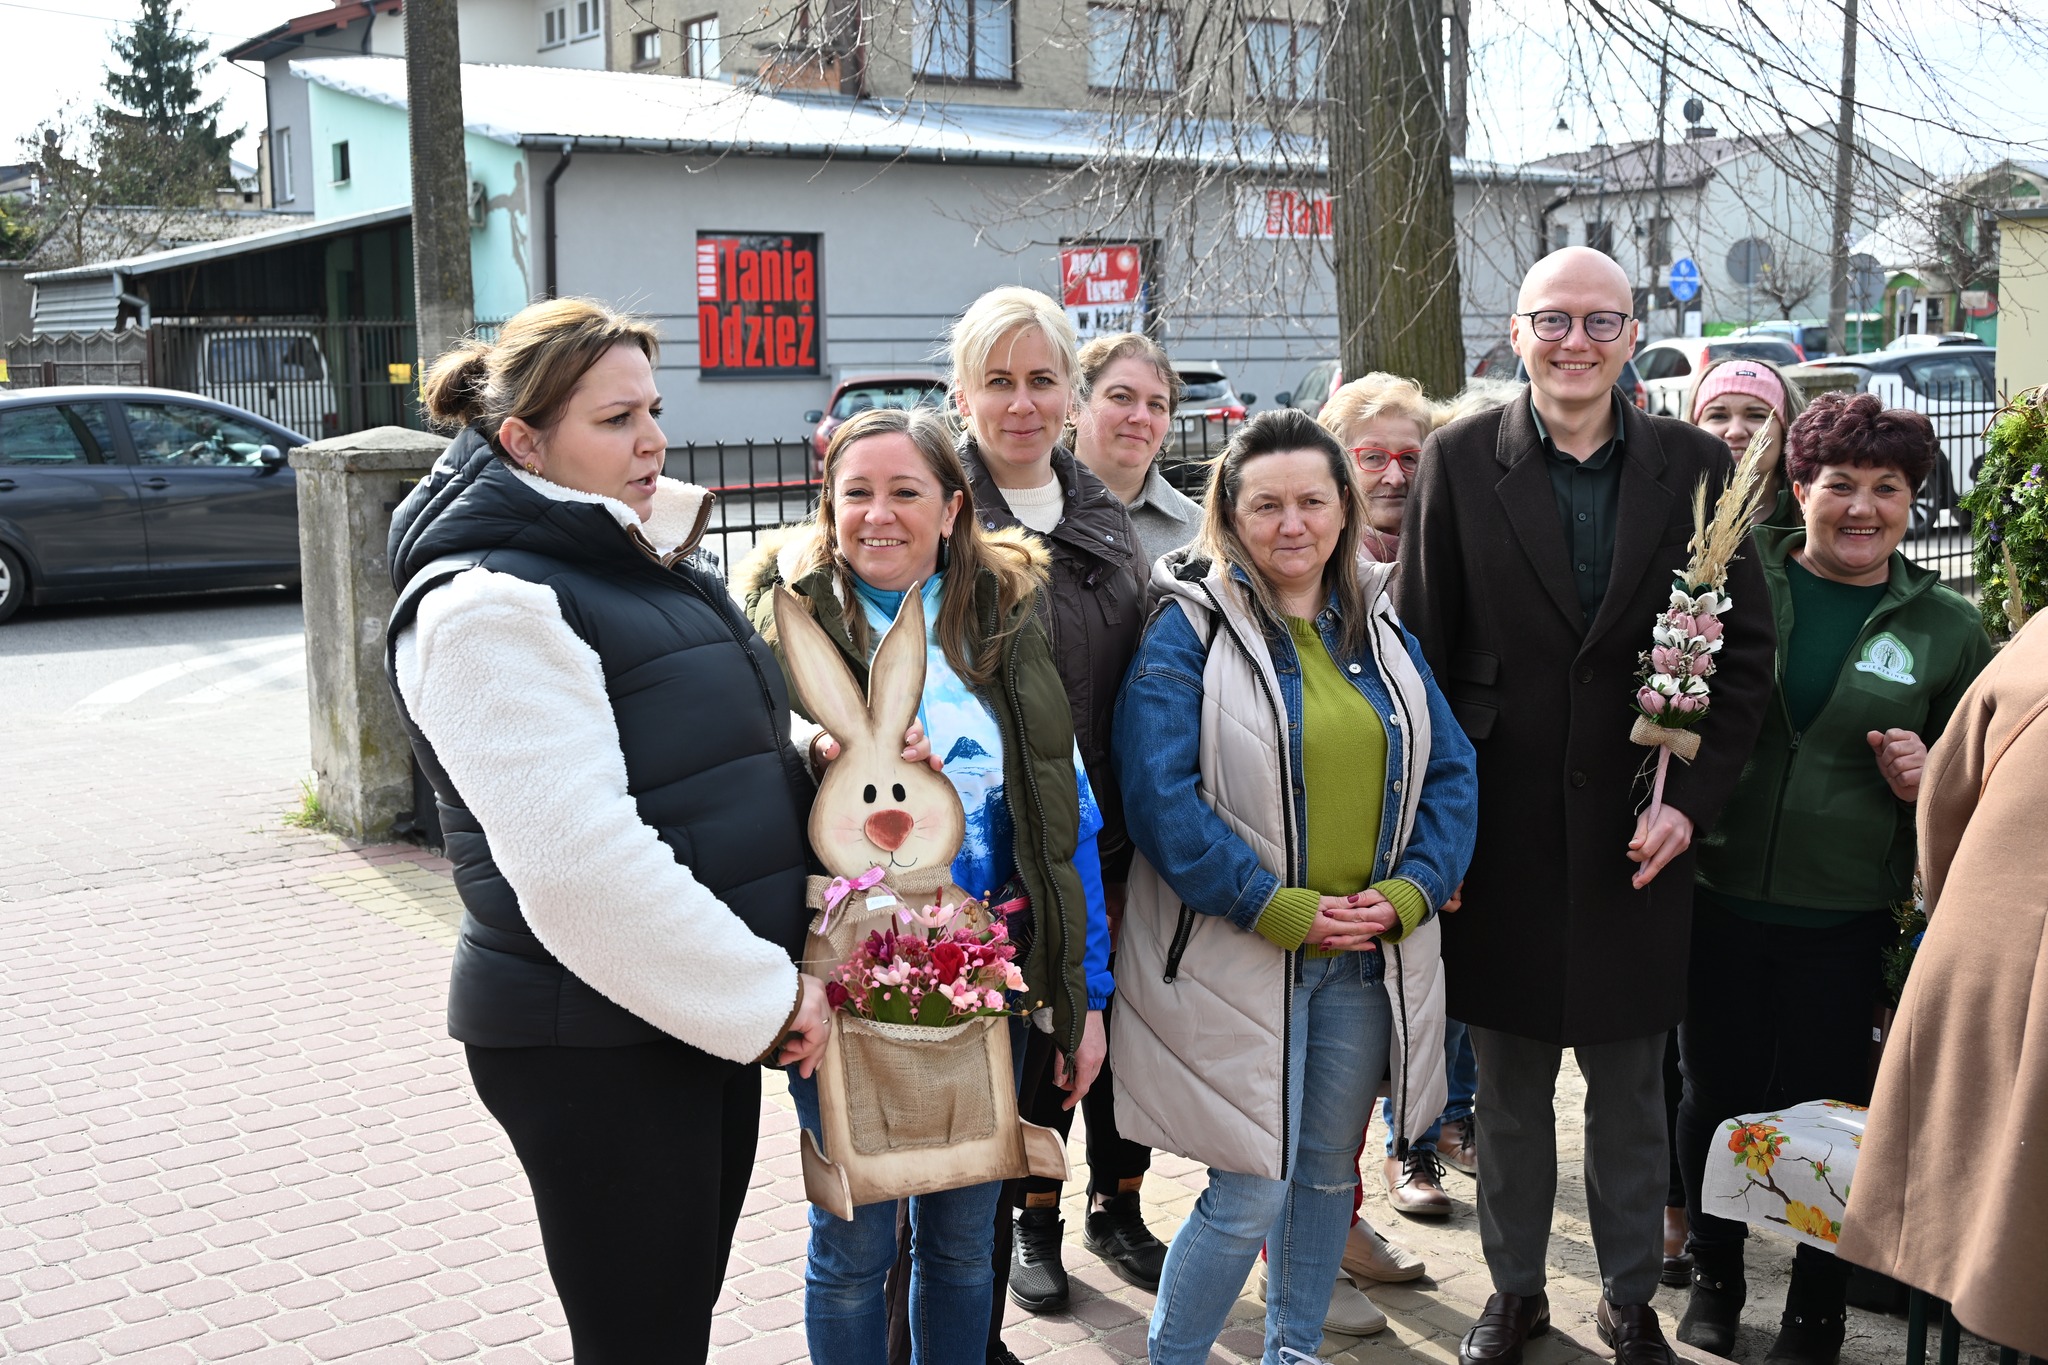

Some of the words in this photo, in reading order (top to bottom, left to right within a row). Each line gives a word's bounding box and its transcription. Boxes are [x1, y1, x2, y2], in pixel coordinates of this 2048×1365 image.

[1282, 190, 1332, 234] Tani
[719, 239, 815, 302] Tania
[699, 304, 816, 368] Odzież
